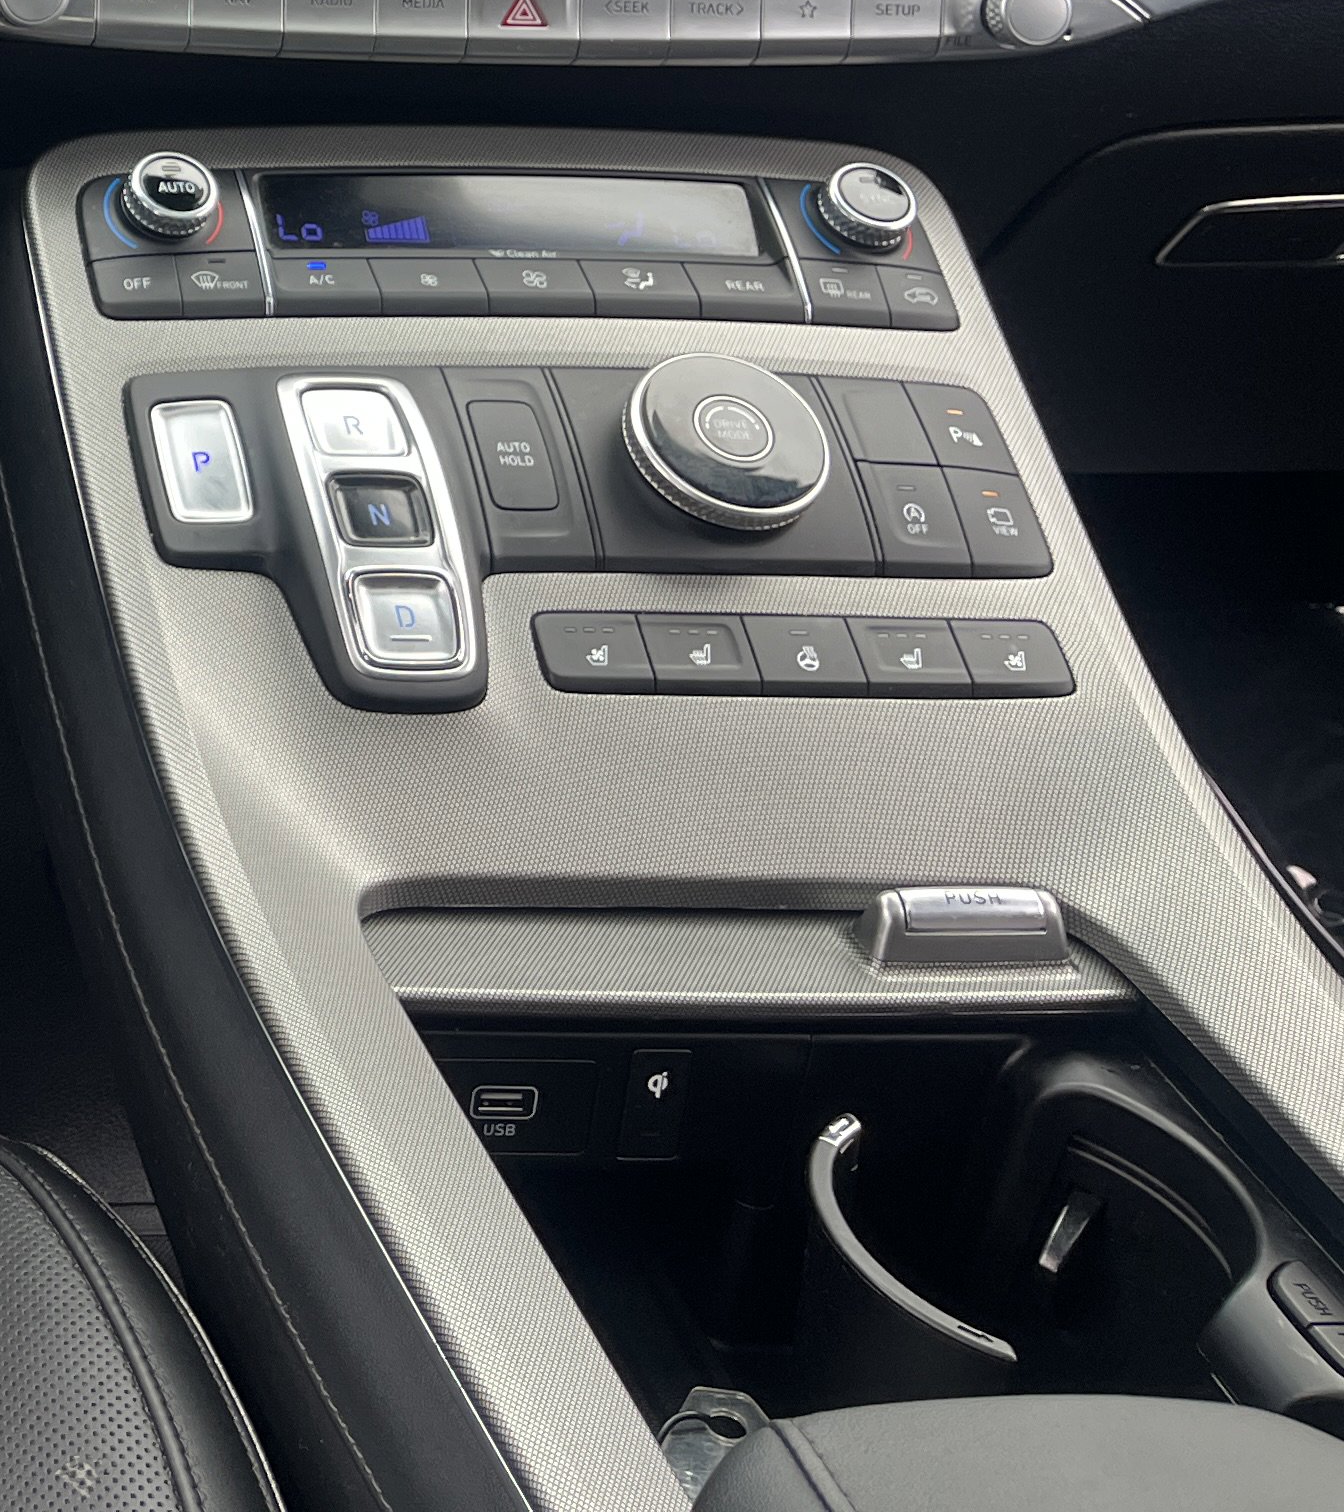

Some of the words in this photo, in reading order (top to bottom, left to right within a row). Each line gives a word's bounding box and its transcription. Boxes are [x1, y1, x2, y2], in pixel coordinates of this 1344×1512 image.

[874, 2, 921, 18] SETUP
[158, 181, 195, 194] AUTO
[275, 213, 323, 241] Lo
[123, 277, 151, 290] OFF
[216, 279, 249, 290] FRONT
[309, 273, 335, 286] A/C
[725, 279, 765, 292] REAR
[342, 414, 363, 436] R
[496, 441, 530, 454] AUTO
[191, 451, 210, 473] P
[499, 454, 534, 467] HOLD
[367, 503, 391, 526] N
[907, 523, 929, 535] OFF
[992, 524, 1018, 537] VIEW
[394, 605, 416, 629] D
[944, 891, 1002, 905] PUSH
[482, 1123, 516, 1136] USB
[1292, 1281, 1333, 1316] PUSH
